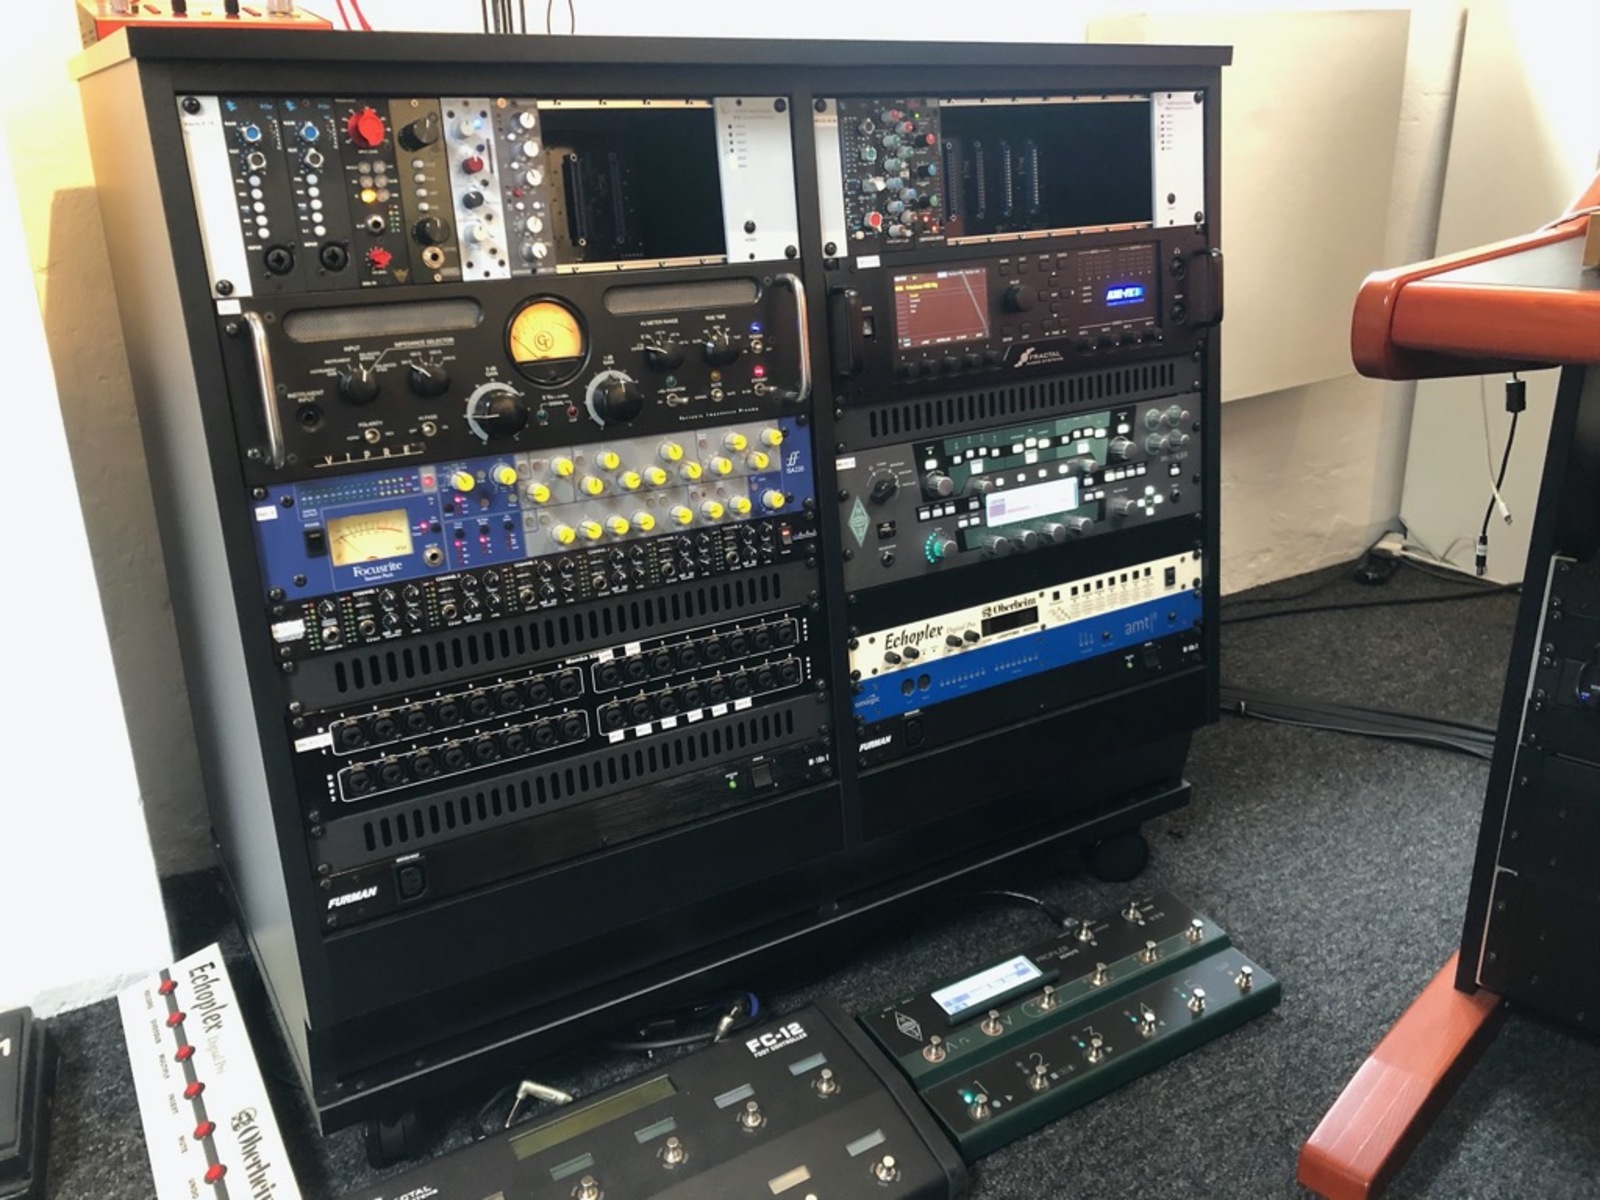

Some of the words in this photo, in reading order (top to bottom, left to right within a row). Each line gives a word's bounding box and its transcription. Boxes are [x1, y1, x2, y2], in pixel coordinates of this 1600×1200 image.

[287, 389, 324, 399] INSTRUMENT
[324, 444, 411, 465] VIPRE
[352, 561, 403, 578] Focusrite
[992, 596, 1036, 615] Oberheim
[884, 622, 944, 651] Echoplex
[859, 734, 892, 753] FURMAN
[327, 885, 378, 911] FURMAN
[188, 961, 230, 1034] Echoplex
[745, 1021, 805, 1054] FC-12
